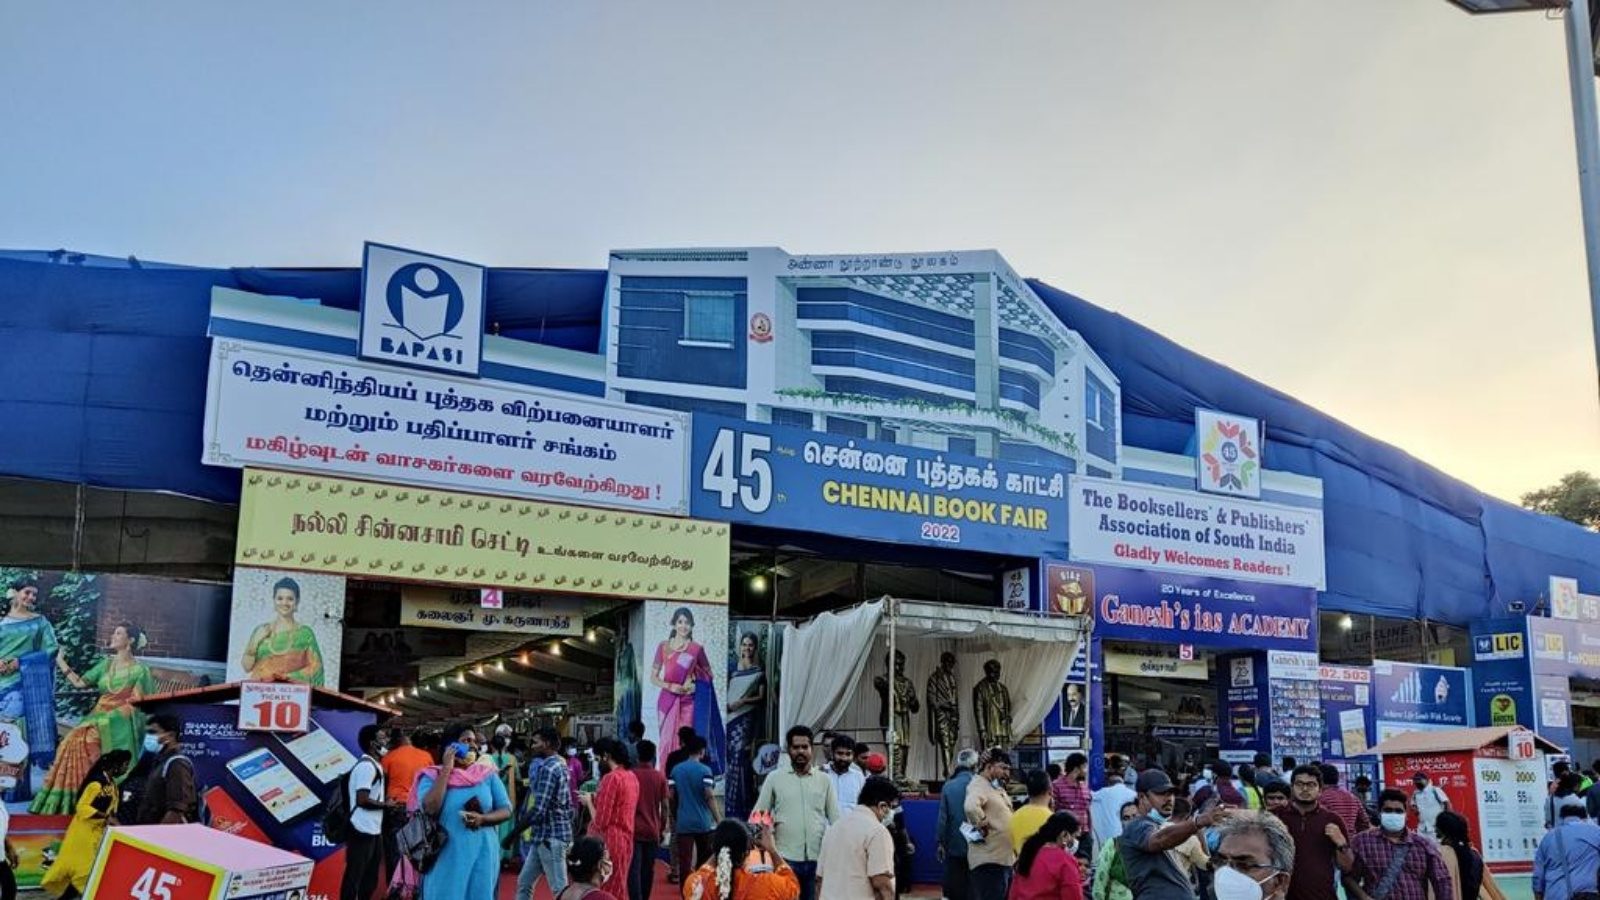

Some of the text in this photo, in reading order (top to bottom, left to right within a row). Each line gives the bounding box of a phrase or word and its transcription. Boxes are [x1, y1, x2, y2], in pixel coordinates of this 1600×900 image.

[380, 337, 464, 364] BAPASI
[232, 360, 675, 440] தென்னிந்தியப் புத்தக விற்பனையாளர்
[304, 403, 617, 461] மற்றும் பதிப்பாளர் சங்கம்
[246, 435, 369, 462] மகிழ்வுடன்
[376, 452, 515, 479] வாசகர்களை
[521, 469, 650, 499] வரவேற்கிறது
[703, 428, 773, 514] 45
[803, 440, 1064, 499] சென்னை புத்தகக் காட்சி
[822, 480, 1048, 530] CHENNAI BOOK FAIR
[1082, 488, 1113, 509] The
[1216, 507, 1227, 523] &
[291, 509, 693, 571] நல்லி சின்னசாமி செட்டி உங்களை வரவேற்கிறது
[921, 522, 960, 542] 2022
[1099, 514, 1296, 555] Association of South India
[1114, 543, 1161, 565] Gladly
[1164, 549, 1229, 570] Welcomes
[1233, 557, 1284, 576] Readers
[483, 588, 500, 606] 4
[1161, 584, 1255, 602] 20 Years of Excellence
[416, 609, 474, 623] கலைஞர்
[1101, 593, 1311, 640] Ganesh's ias ACADEMY
[1182, 644, 1191, 659] 5
[1496, 635, 1520, 651] LIC
[184, 722, 233, 730] SHANKAR
[253, 701, 301, 729] 10
[184, 729, 248, 738] IAS ACADEMY
[1407, 756, 1446, 765] SHANKAR
[1516, 741, 1533, 758] 10
[1422, 762, 1461, 770] ACADEMY
[1481, 770, 1536, 782] 1500 2000
[130, 866, 177, 900] 45
